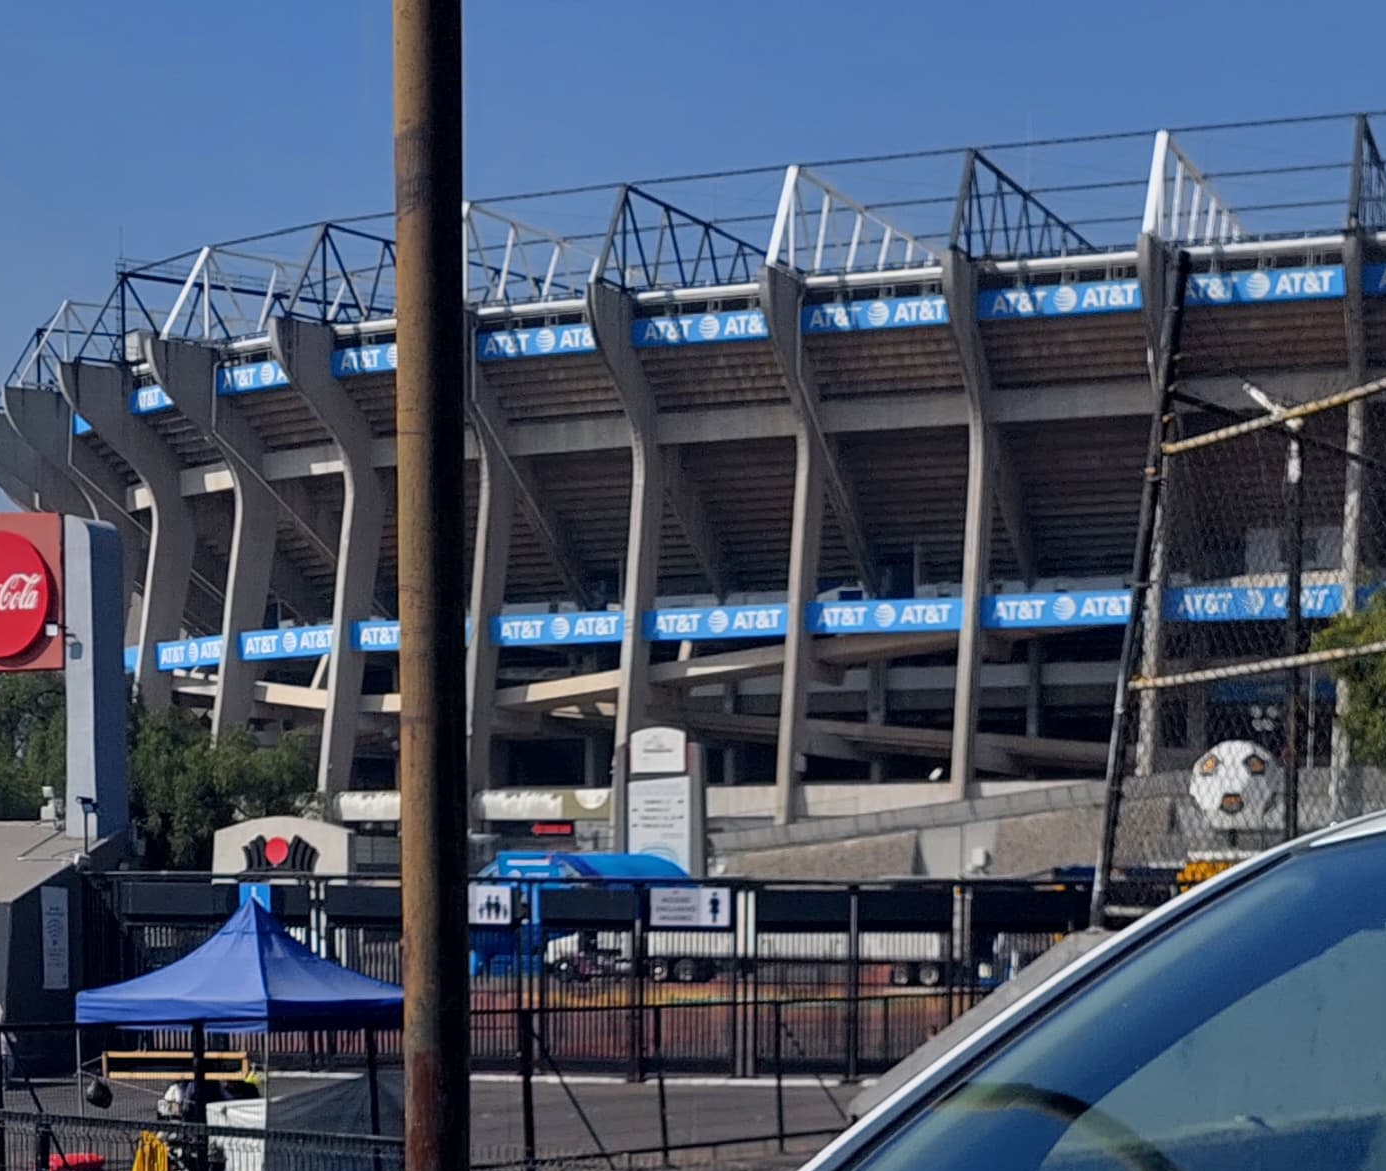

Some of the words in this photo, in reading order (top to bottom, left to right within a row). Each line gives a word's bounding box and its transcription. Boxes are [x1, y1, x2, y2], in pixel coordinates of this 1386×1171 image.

[1275, 269, 1335, 296] AT&T
[992, 289, 1046, 315] AT&T
[1082, 283, 1140, 308] AT&T
[809, 303, 863, 329] AT&T
[893, 299, 946, 323] AT&T
[644, 318, 690, 343] AT&T
[724, 312, 765, 336] AT&
[483, 331, 530, 355] AT&T
[341, 350, 381, 374] AT&T
[223, 367, 257, 390] AT&T
[817, 606, 867, 627] AT&T
[900, 603, 953, 625] AT&T
[996, 598, 1047, 621] AT&T
[1081, 595, 1131, 617] AT&T
[502, 619, 545, 640] AT&T
[574, 615, 619, 636] AT&T
[656, 613, 701, 634] AT&T
[733, 609, 781, 630] AT&T
[161, 644, 185, 664] AT&T
[245, 635, 278, 655] AT&T
